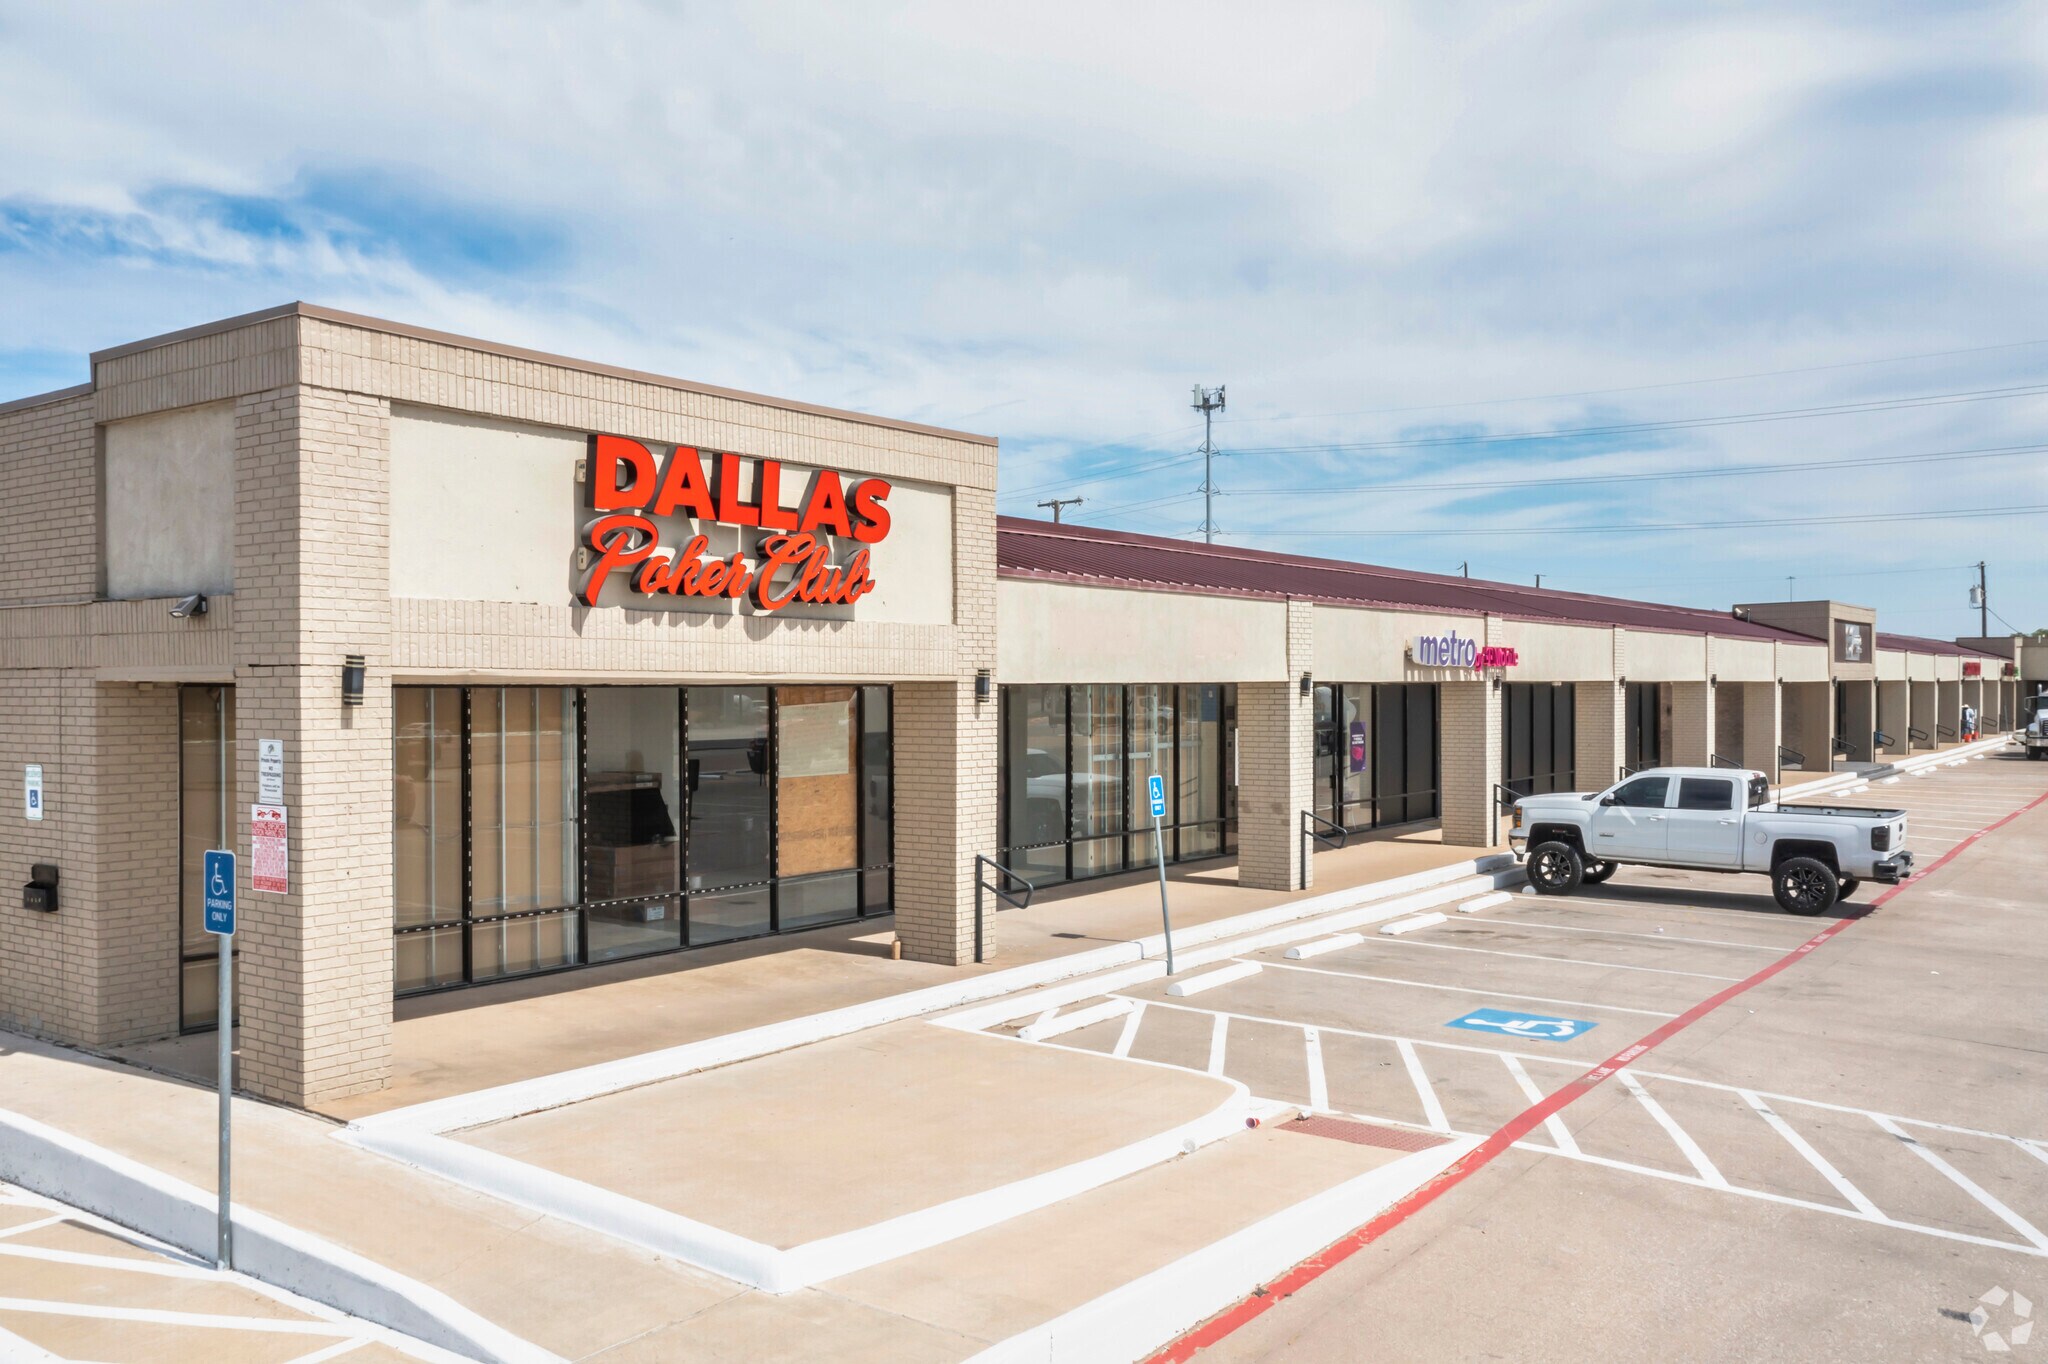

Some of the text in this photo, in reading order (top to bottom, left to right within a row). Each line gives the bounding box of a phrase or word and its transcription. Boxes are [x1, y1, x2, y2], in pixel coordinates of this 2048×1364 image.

[587, 434, 892, 543] DALLAS
[579, 514, 876, 610] Poker Club
[1418, 630, 1477, 667] metro
[207, 898, 233, 910] PARKING
[211, 911, 228, 923] ONLY
